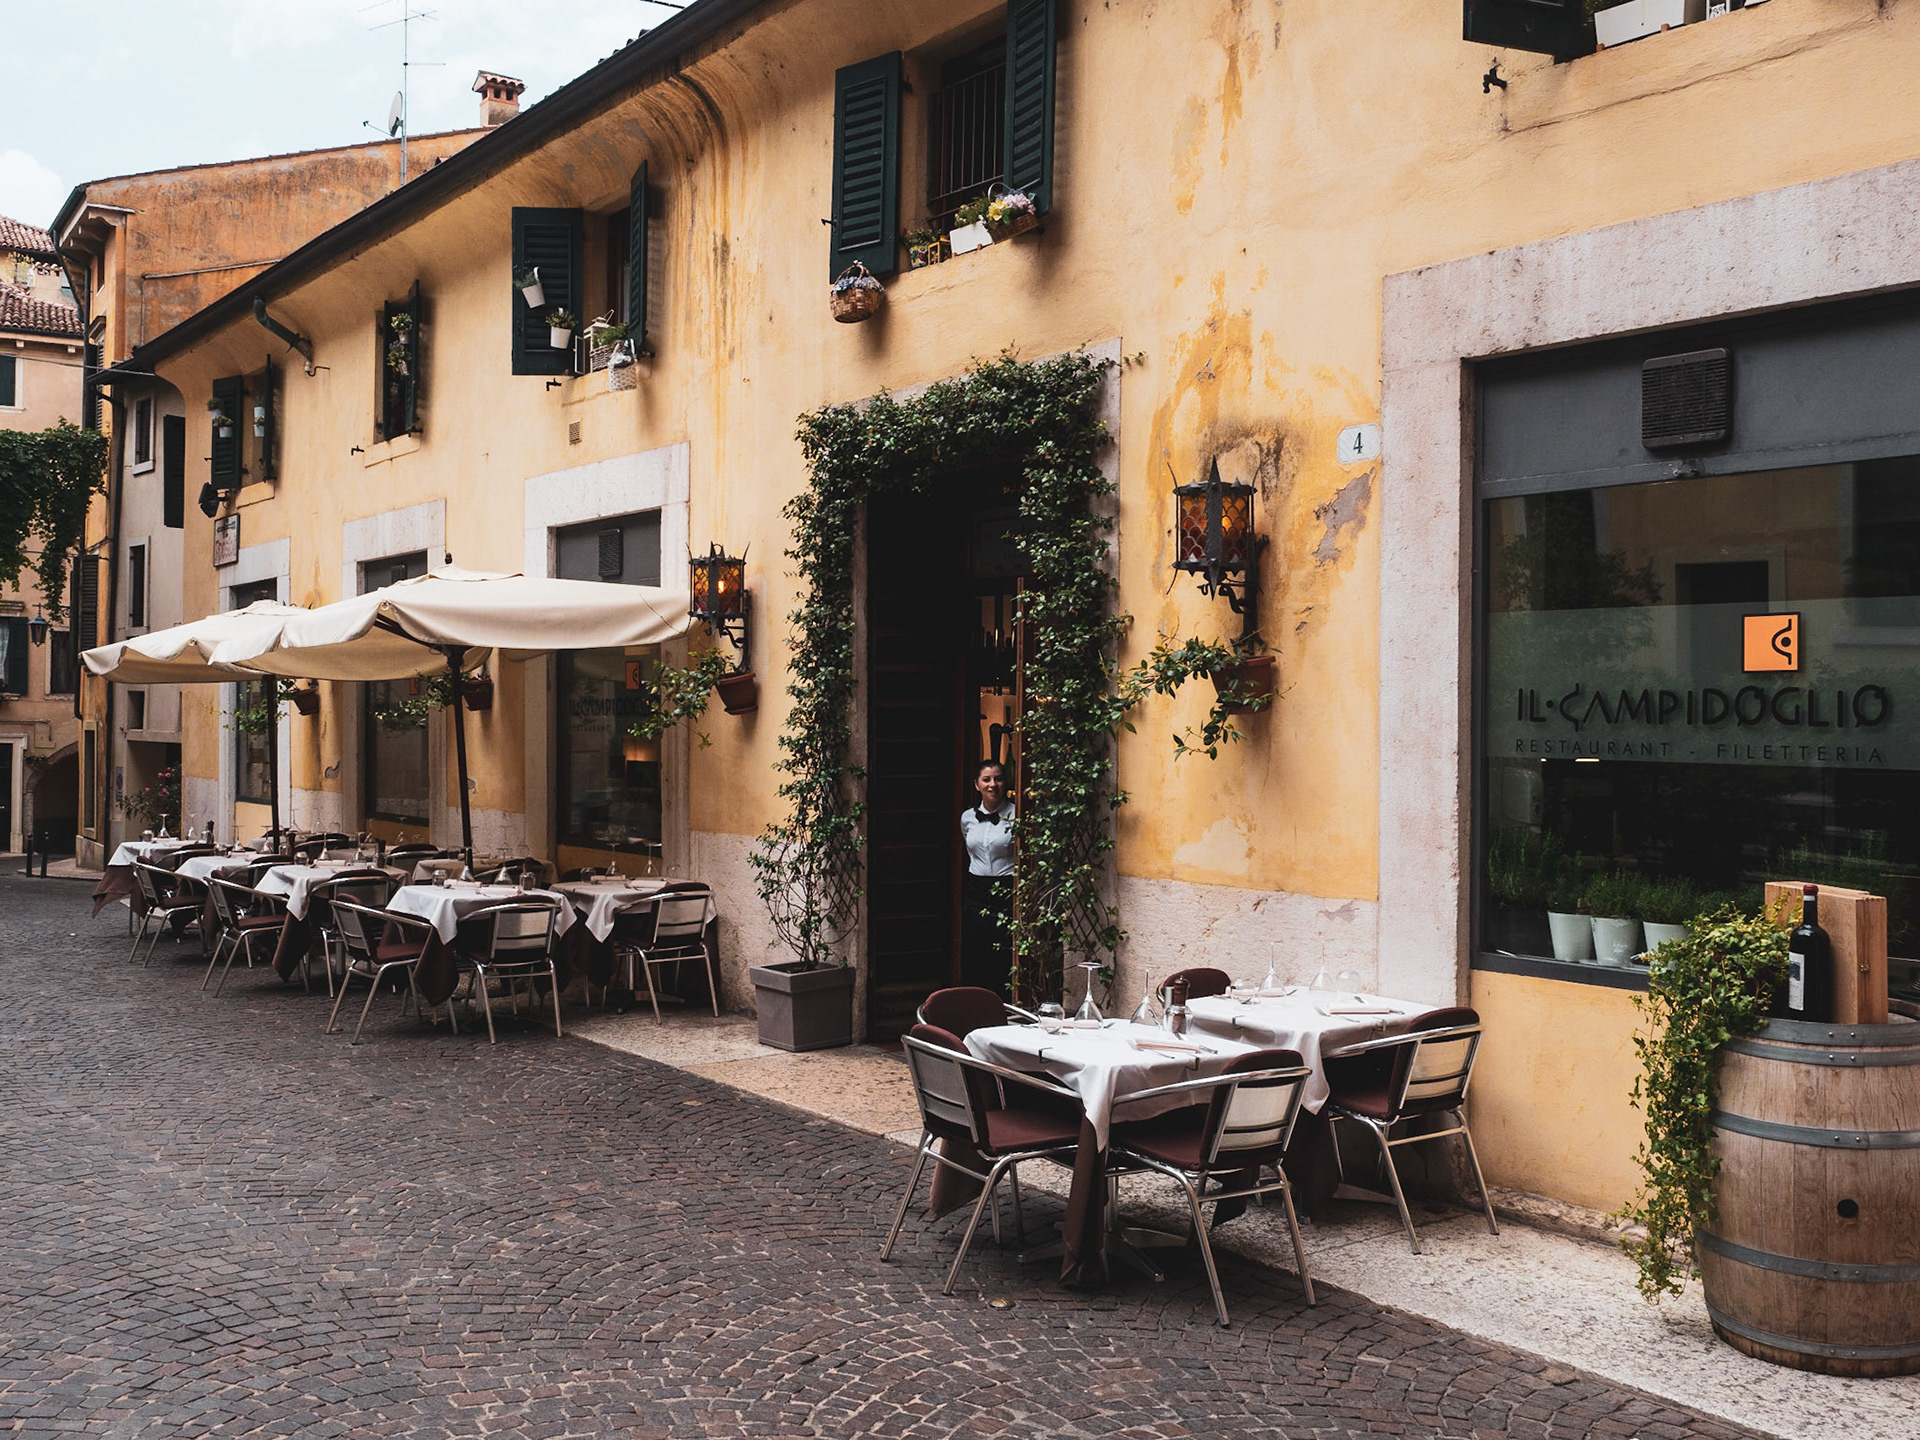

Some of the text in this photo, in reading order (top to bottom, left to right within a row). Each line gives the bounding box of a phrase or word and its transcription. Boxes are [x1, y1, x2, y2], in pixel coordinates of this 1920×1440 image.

[1353, 432, 1363, 454] 4
[1515, 739, 1670, 757] RESTAURANT
[1717, 743, 1882, 763] FILETTERIA
